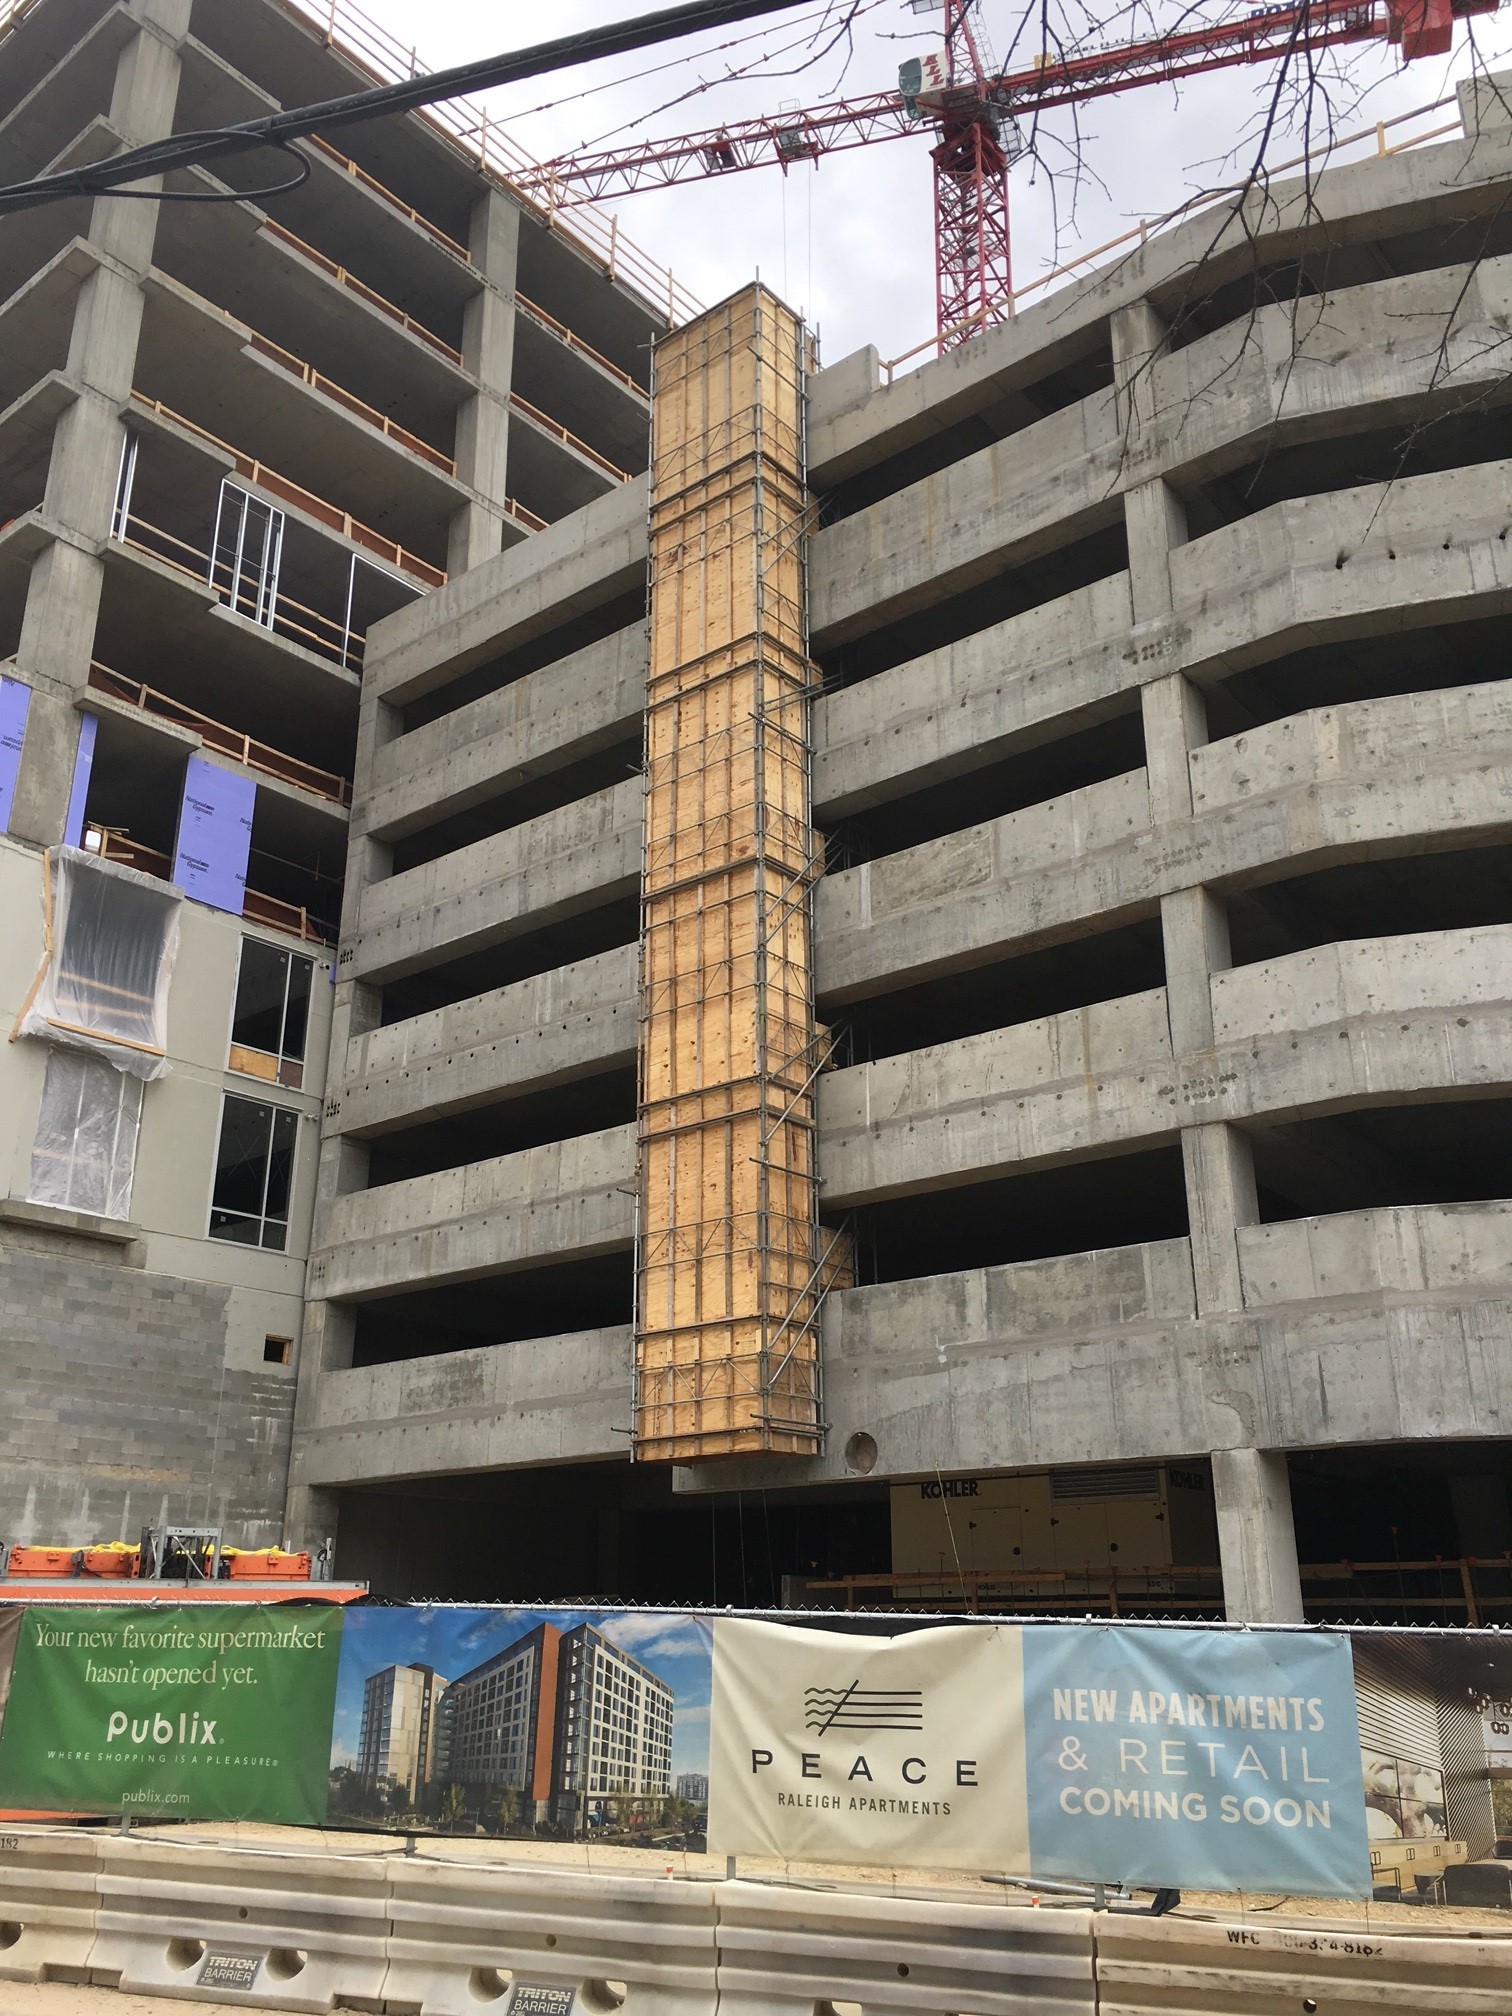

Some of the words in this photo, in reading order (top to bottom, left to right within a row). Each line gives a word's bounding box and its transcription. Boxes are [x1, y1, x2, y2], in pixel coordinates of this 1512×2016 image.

[922, 54, 944, 86] ALL
[921, 1479, 979, 1499] KOHLER
[1169, 1470, 1205, 1491] KOHLER
[35, 1623, 74, 1648] Your
[77, 1629, 118, 1648] new
[121, 1624, 194, 1649] favorite
[198, 1625, 326, 1655] supermarket
[85, 1659, 138, 1684] hasn't
[142, 1660, 217, 1691] opened
[221, 1666, 258, 1691] yet.
[1053, 1688, 1117, 1723] NEW
[1128, 1690, 1325, 1732] APARTMENTS
[47, 1750, 91, 1761] WHERE
[97, 1752, 166, 1763] SHOPPING
[174, 1754, 186, 1764] IS
[191, 1755, 198, 1764] A
[751, 1749, 979, 1787] PEACE
[1058, 1736, 1089, 1771] &
[1119, 1738, 1330, 1783] RETAIL
[121, 1789, 190, 1804] publix.com
[777, 1792, 841, 1810] RALEIGH
[849, 1797, 951, 1816] APARTMENTS
[1059, 1786, 1207, 1821] COMING
[1220, 1795, 1331, 1829] SOON
[209, 1956, 258, 1970] TRITON
[204, 1967, 252, 1982] BARRIER
[517, 1986, 572, 2002] TRITON
[513, 1999, 567, 2015] BARRIER
